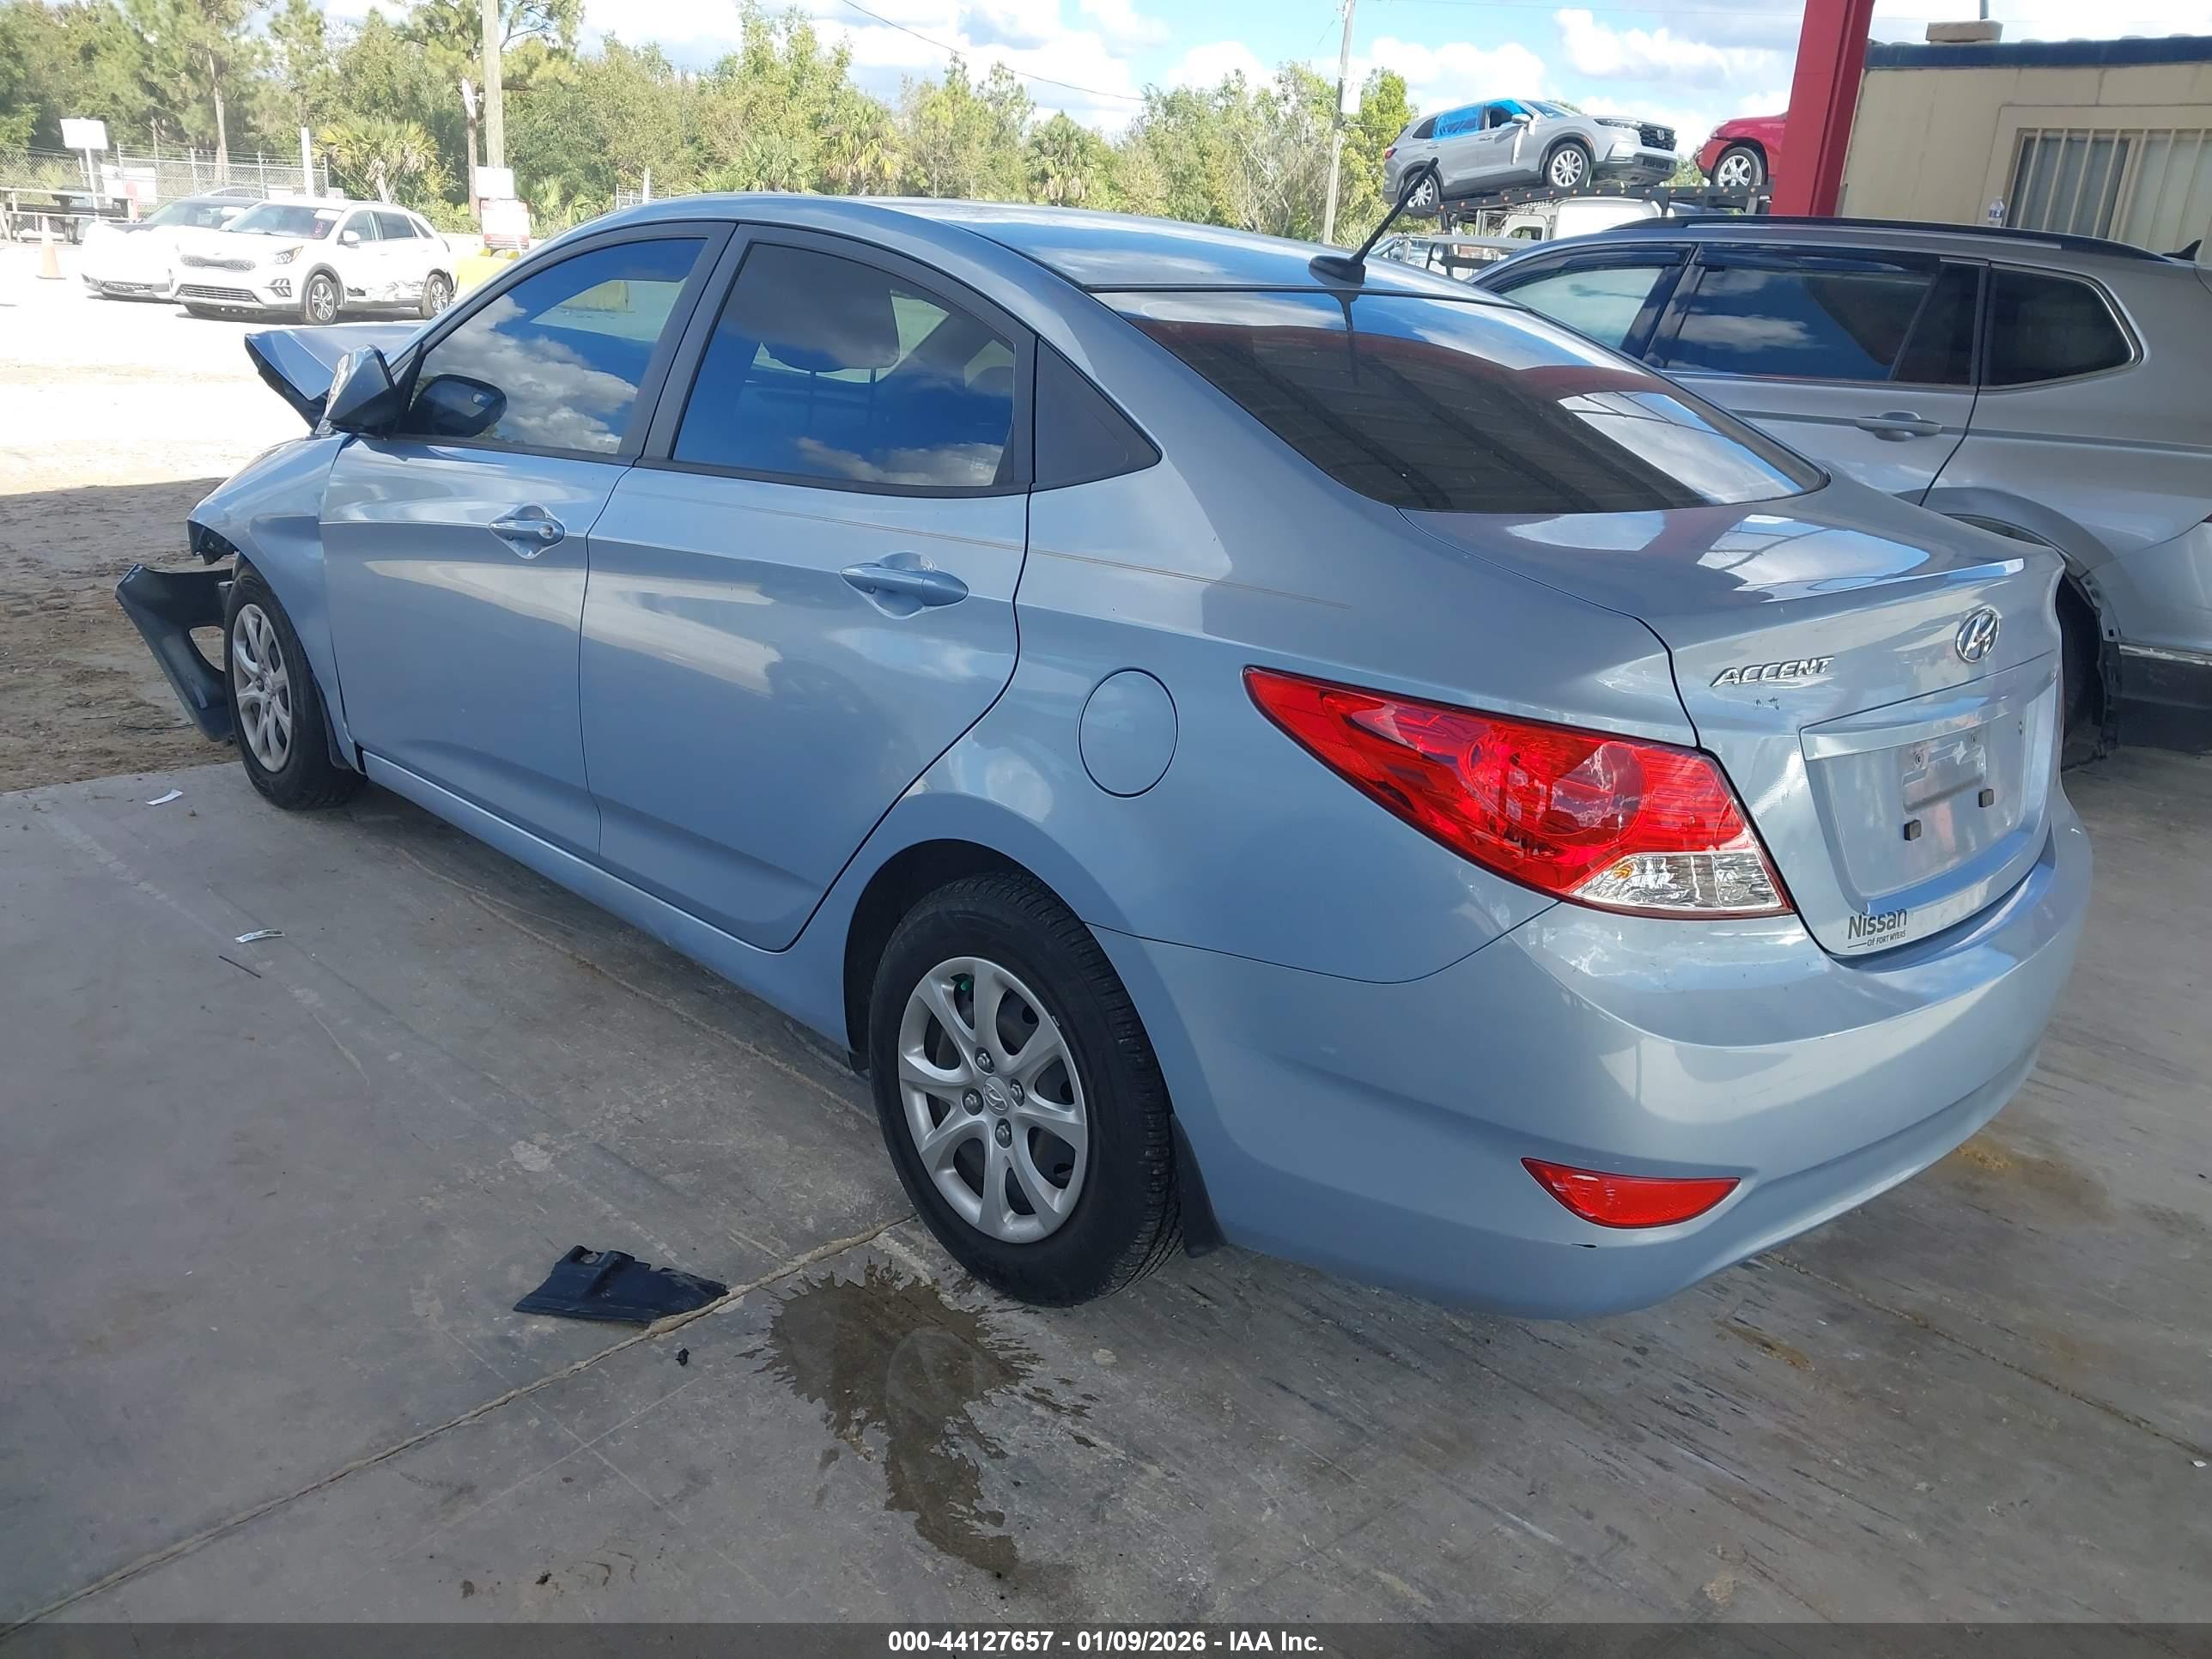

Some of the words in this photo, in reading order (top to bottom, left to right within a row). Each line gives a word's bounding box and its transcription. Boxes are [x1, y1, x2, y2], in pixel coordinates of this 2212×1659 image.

[1711, 656, 1834, 687] ACCENT
[1848, 908, 1907, 939] Nissan
[1876, 934, 1889, 945] FORT
[1890, 930, 1906, 941] MYERS
